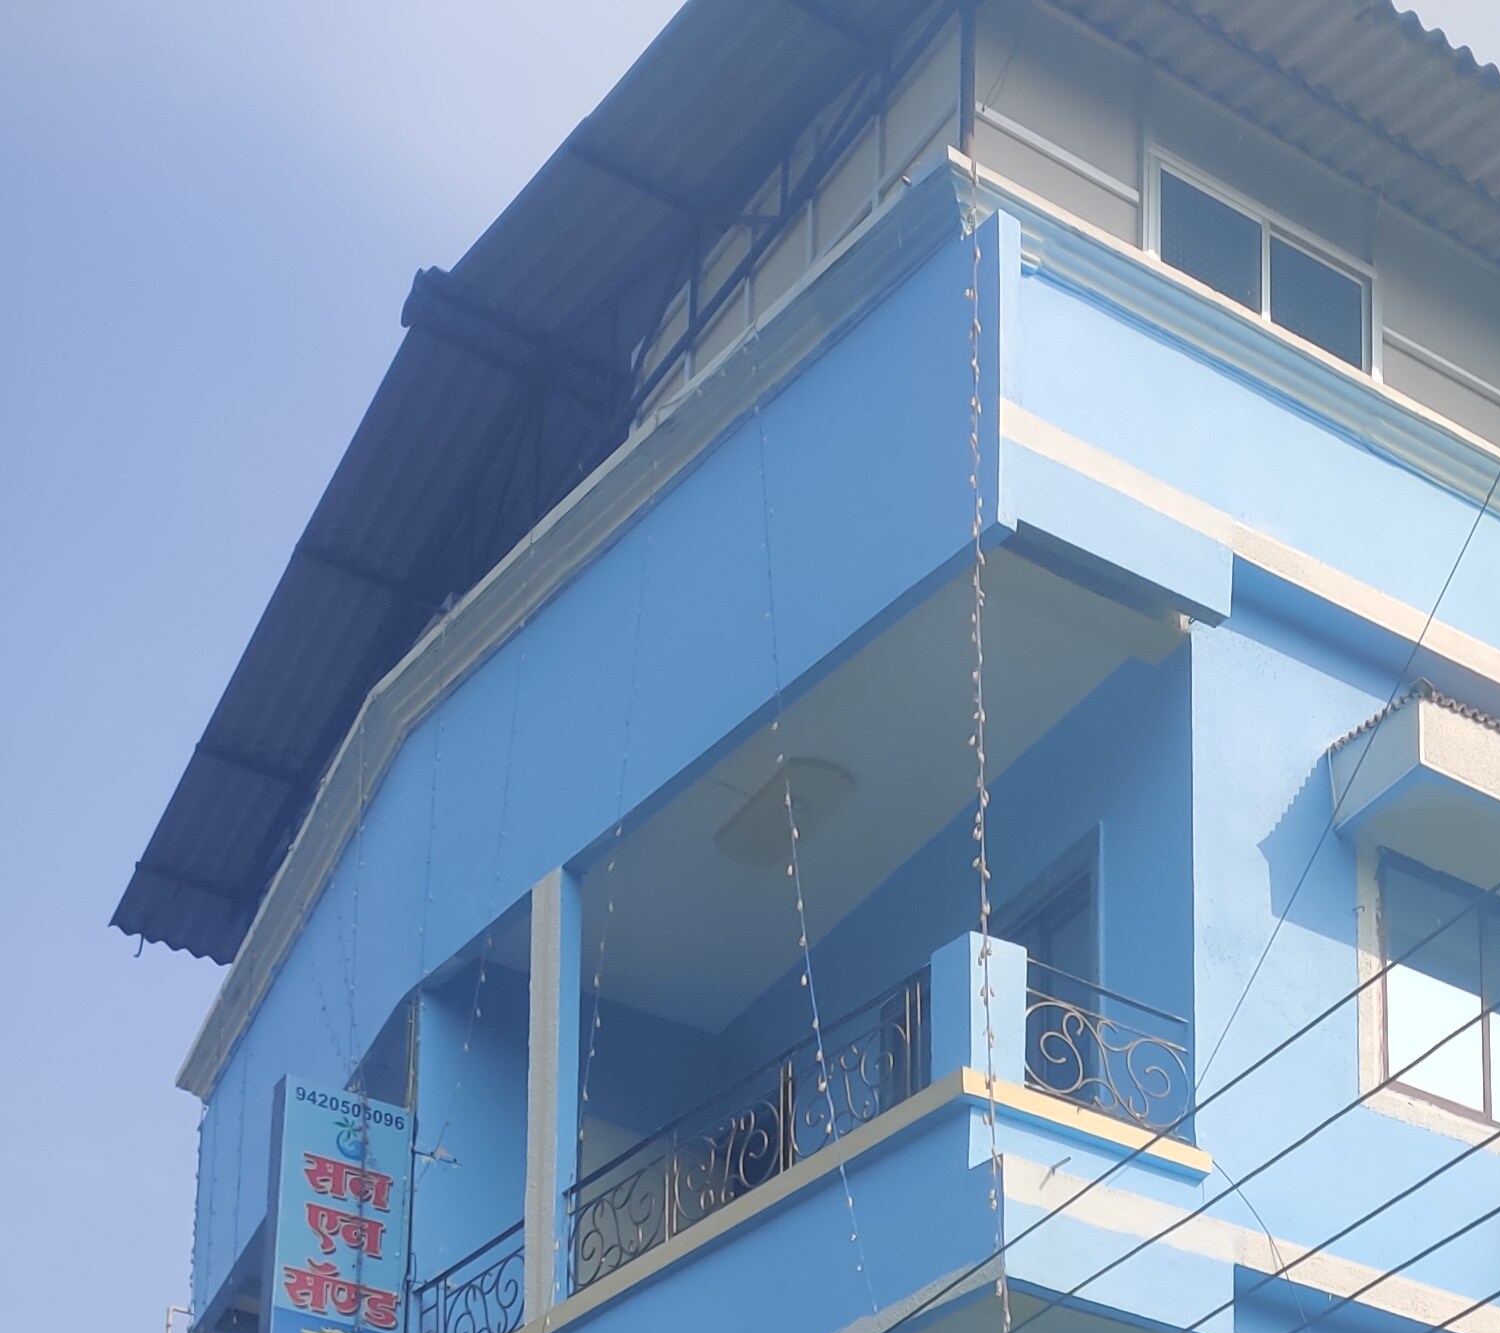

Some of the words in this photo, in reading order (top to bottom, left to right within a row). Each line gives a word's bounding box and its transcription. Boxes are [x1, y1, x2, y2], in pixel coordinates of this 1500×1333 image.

[296, 1087, 405, 1131] 9420505096
[303, 1152, 393, 1212] सन
[305, 1202, 385, 1259] एन
